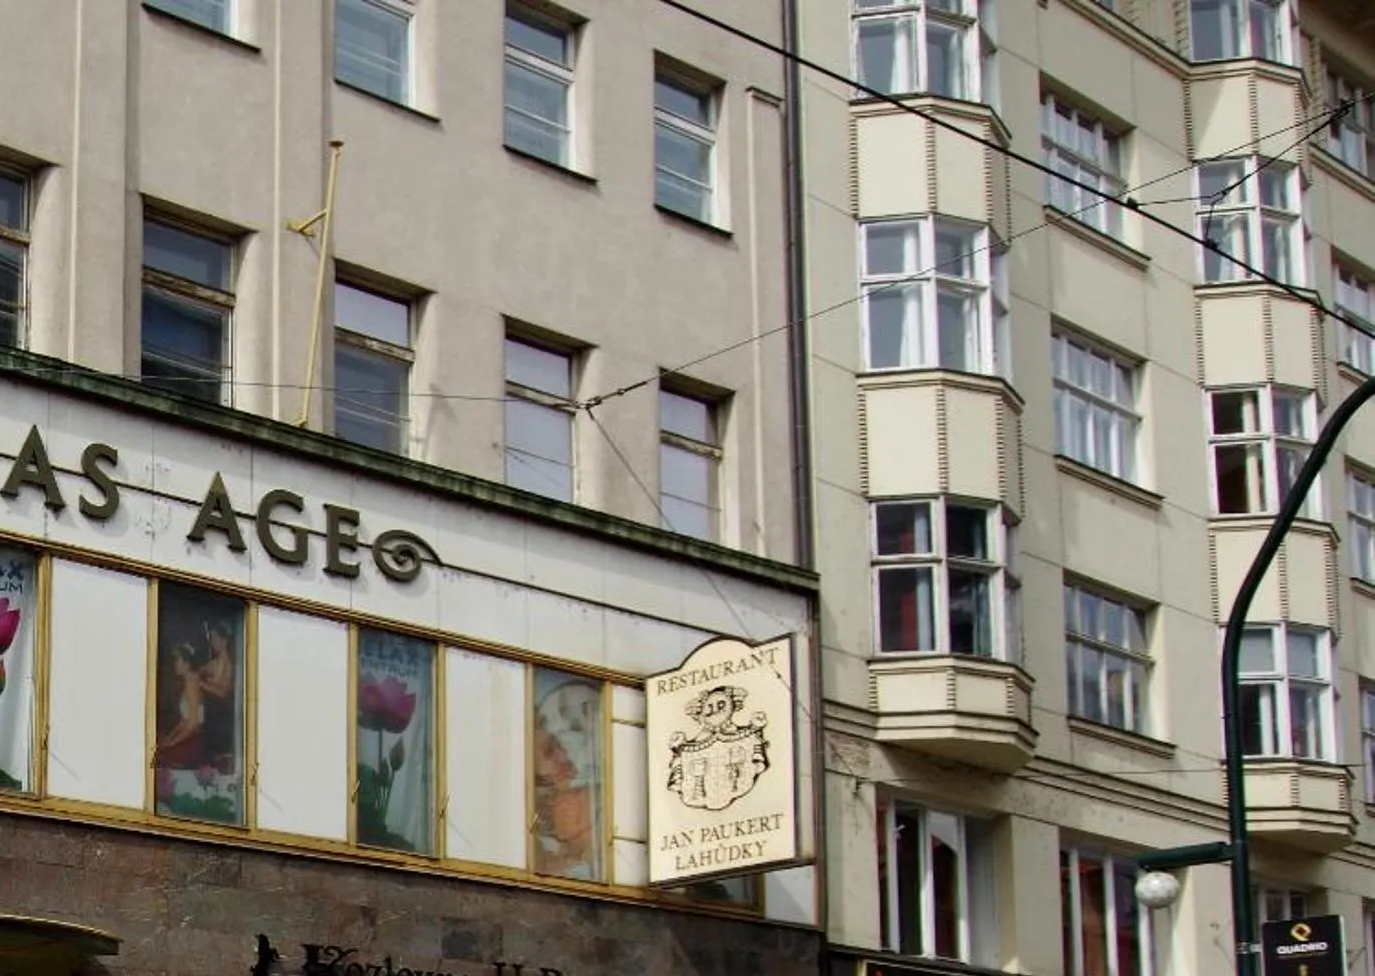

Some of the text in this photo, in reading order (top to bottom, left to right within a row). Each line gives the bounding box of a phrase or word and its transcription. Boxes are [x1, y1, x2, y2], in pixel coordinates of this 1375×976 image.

[656, 647, 779, 696] RESTAURANT
[660, 813, 785, 852] JAN PAUKERT
[1276, 942, 1329, 954] QUADRIO
